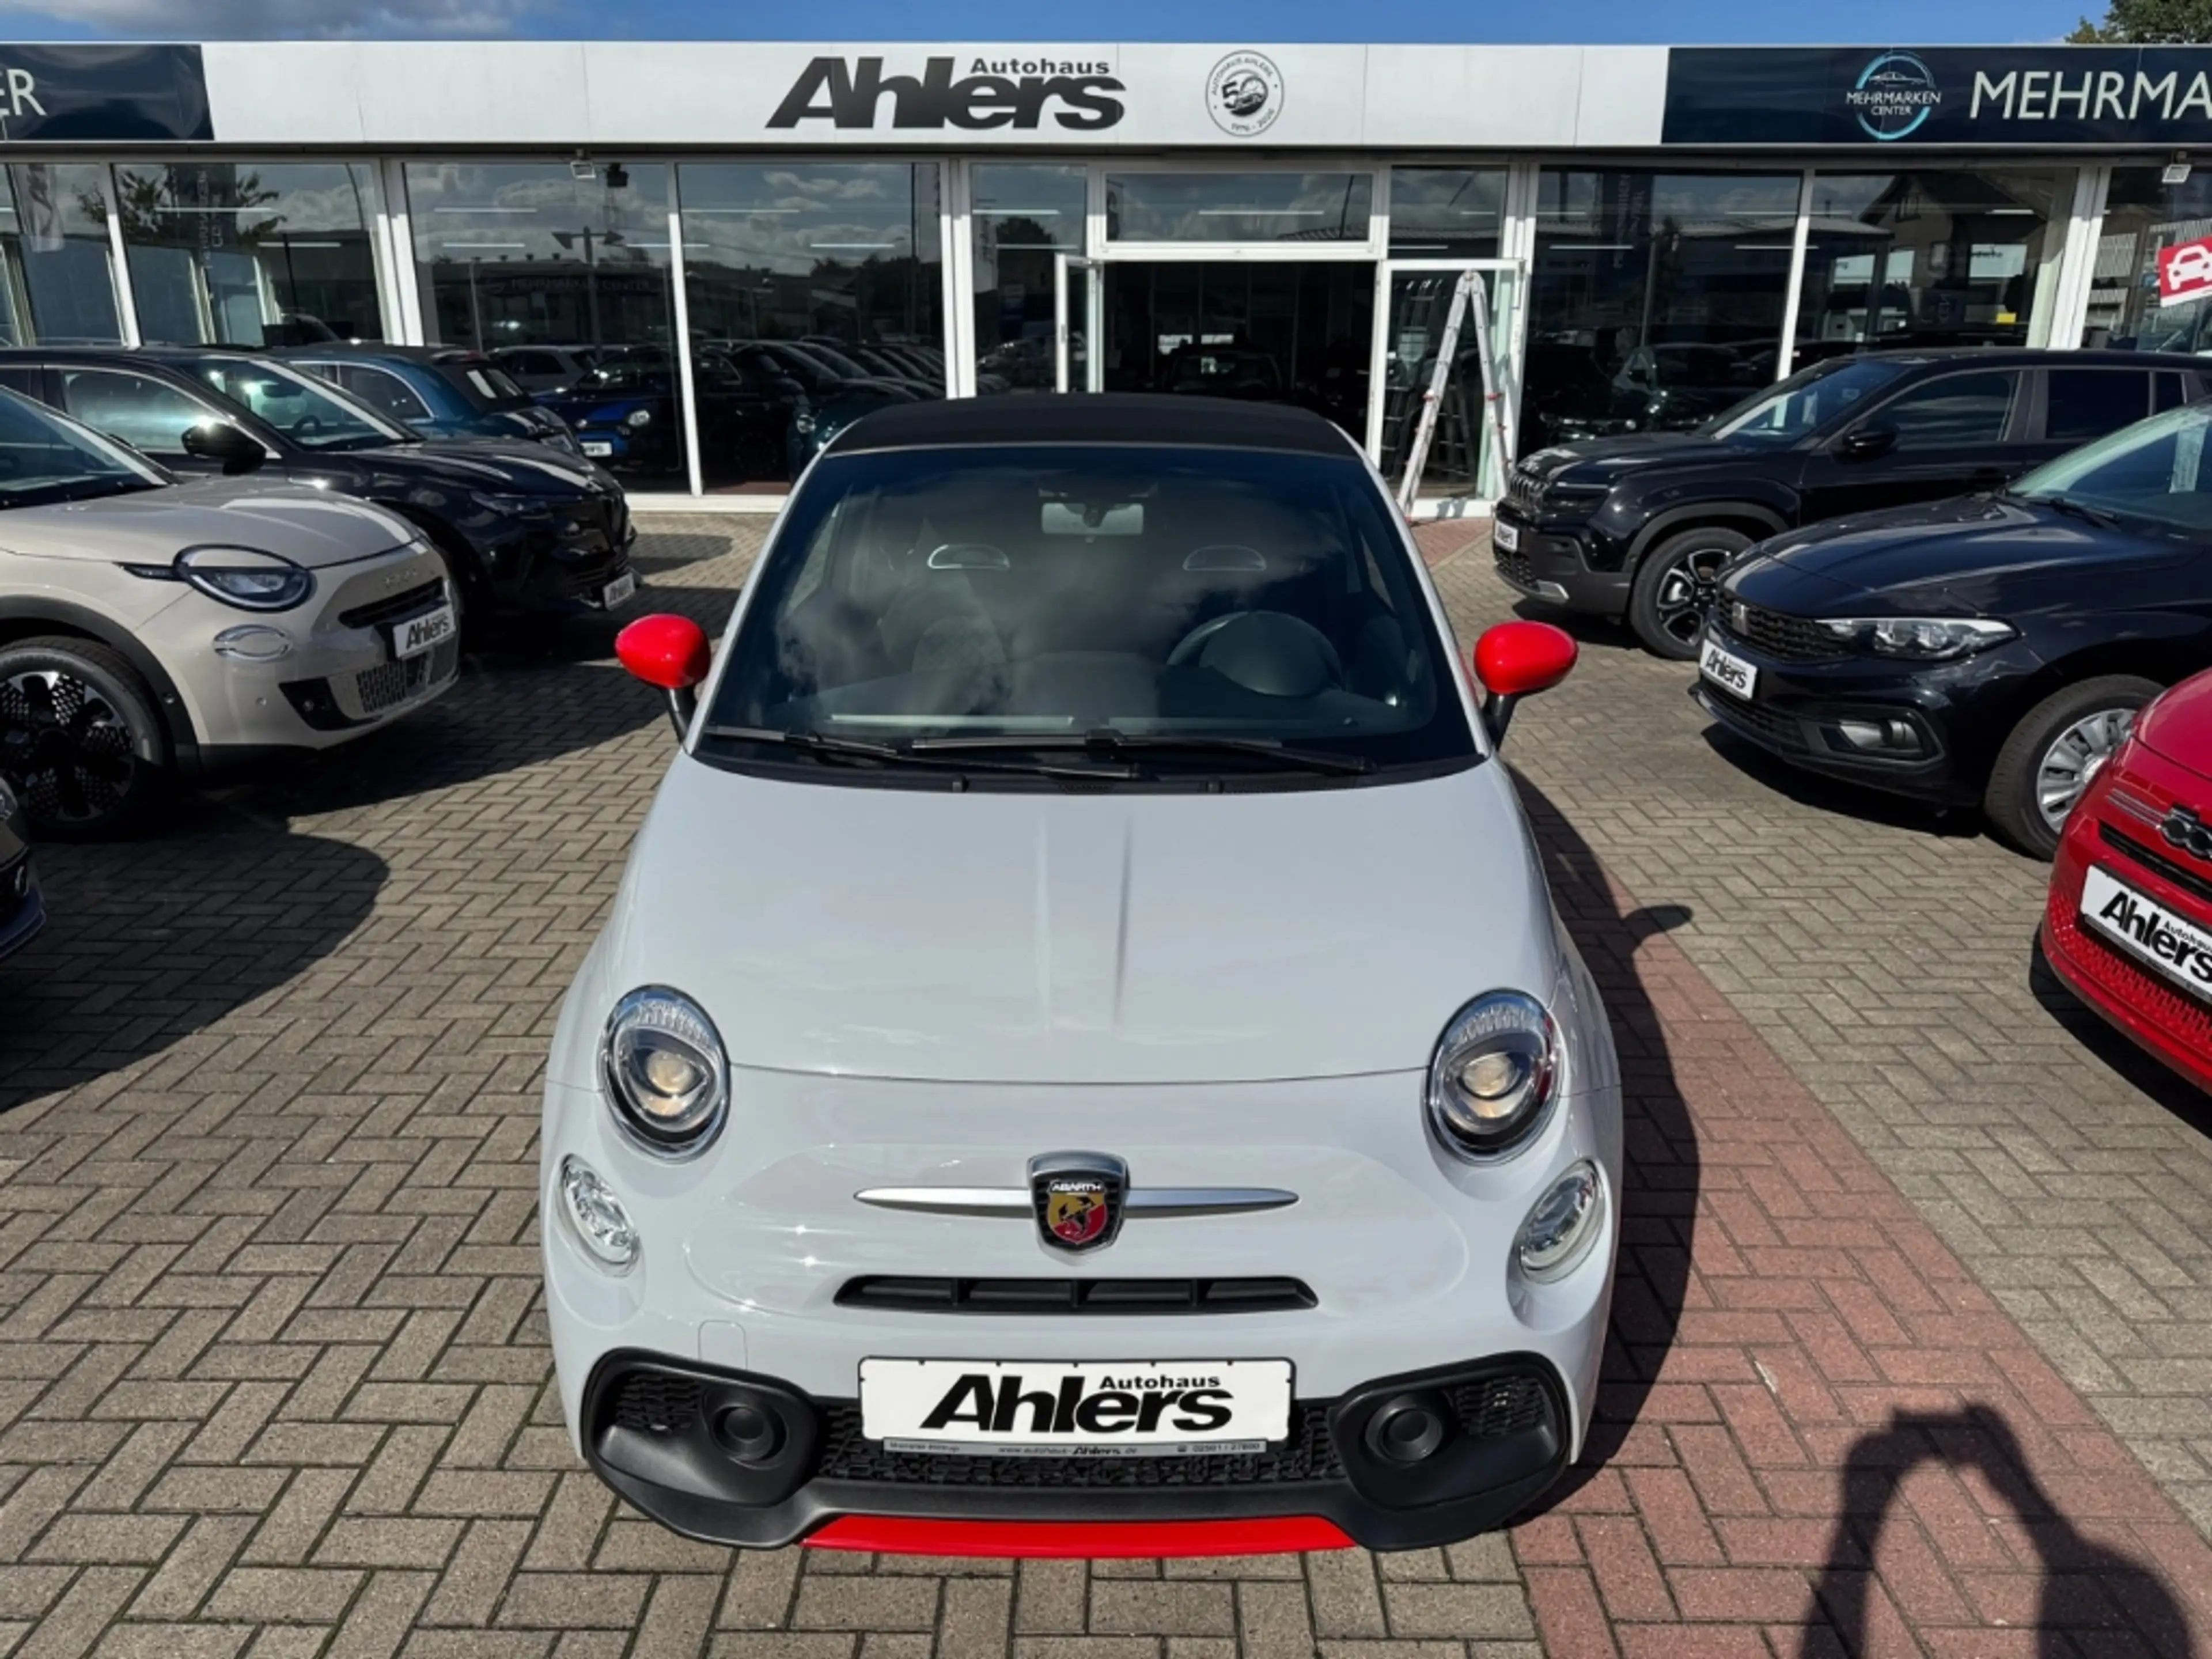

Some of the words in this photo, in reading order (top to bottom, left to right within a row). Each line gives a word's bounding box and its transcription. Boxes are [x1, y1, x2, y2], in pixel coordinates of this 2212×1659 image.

[970, 58, 1109, 74] Autohaus
[766, 57, 1126, 130] Ahlers
[1846, 90, 1942, 105] MEHRMARKEN
[1871, 105, 1912, 116] CENTER
[1051, 1183, 1101, 1192] ABARTH
[1099, 1374, 1220, 1391] Autohaus
[919, 1374, 1233, 1433] Ahlers
